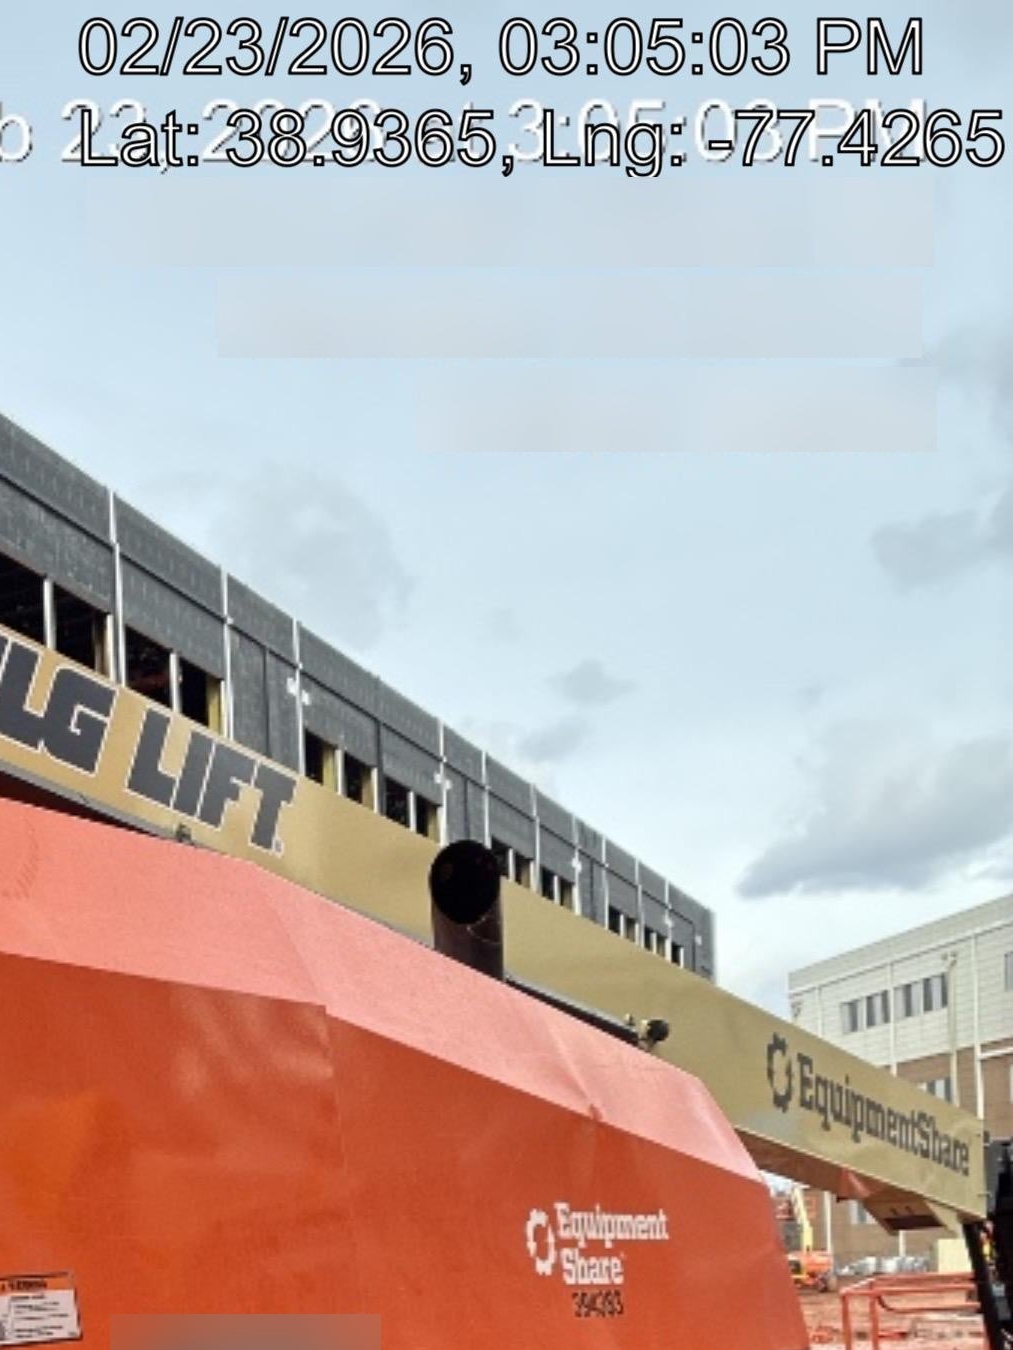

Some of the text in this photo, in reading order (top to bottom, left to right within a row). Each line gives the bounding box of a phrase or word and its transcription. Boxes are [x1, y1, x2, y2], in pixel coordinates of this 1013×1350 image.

[125, 706, 297, 854] LIFT
[797, 1052, 970, 1177] EquipmentShare
[554, 1202, 670, 1249] Equipment
[560, 1248, 625, 1286] Share
